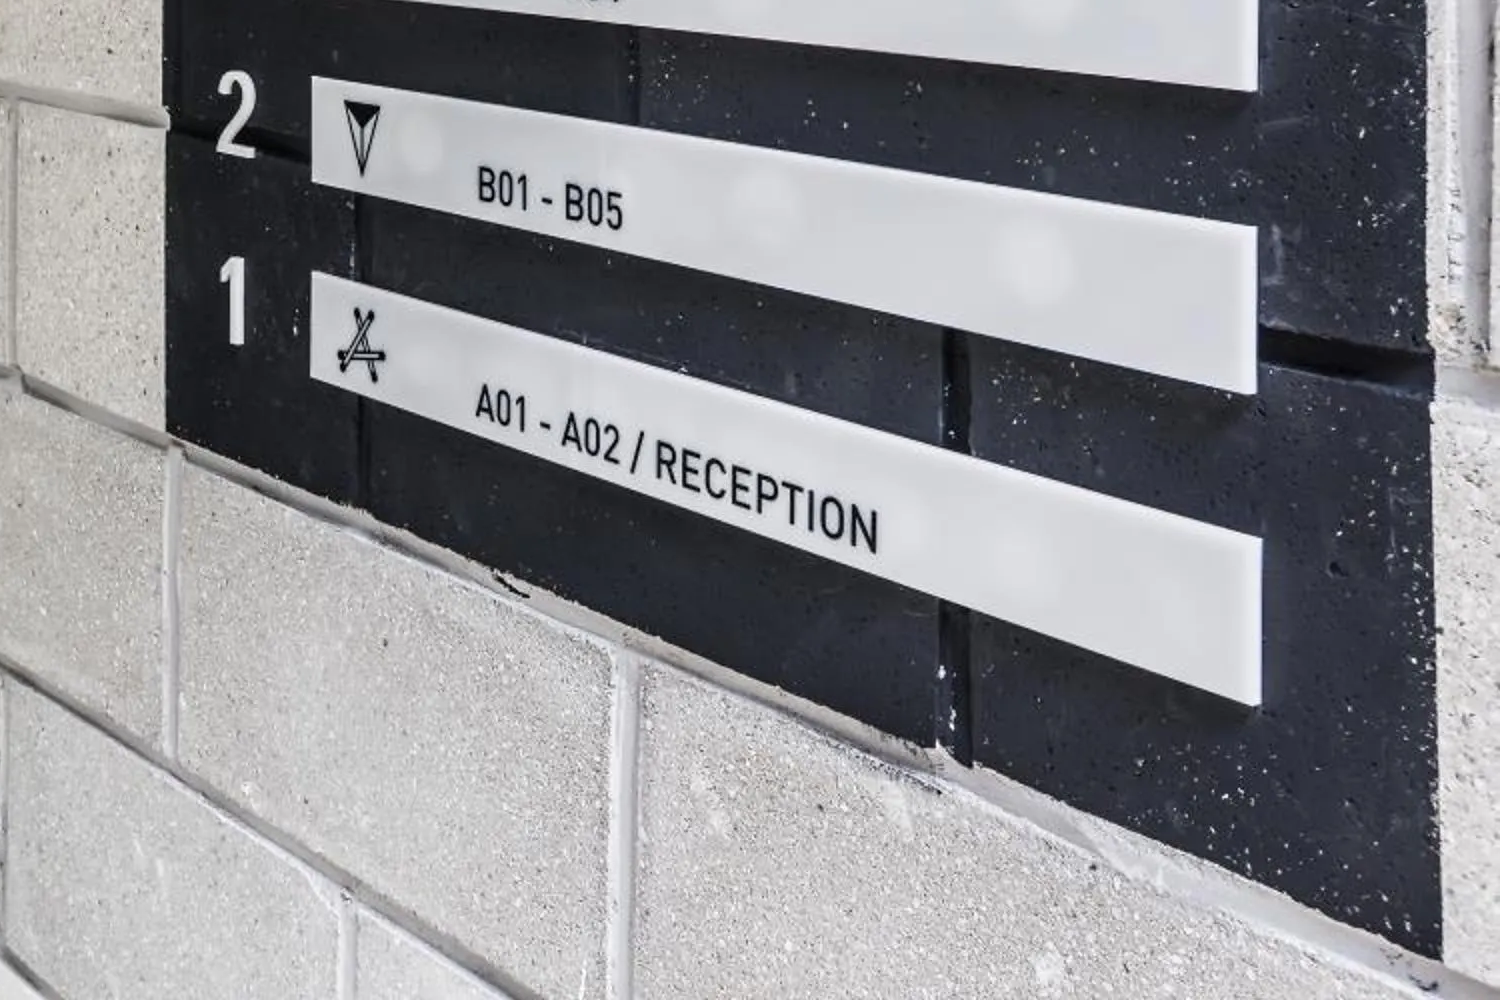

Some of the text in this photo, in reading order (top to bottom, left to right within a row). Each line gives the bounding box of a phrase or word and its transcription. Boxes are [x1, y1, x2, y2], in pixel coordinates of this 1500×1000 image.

[216, 70, 257, 159] 2
[477, 165, 529, 212] B01
[565, 182, 623, 231] B05
[220, 256, 245, 346] 1
[475, 383, 527, 434] A01
[561, 411, 621, 465] A02
[629, 430, 645, 475] /
[655, 440, 879, 554] RECEPTION
